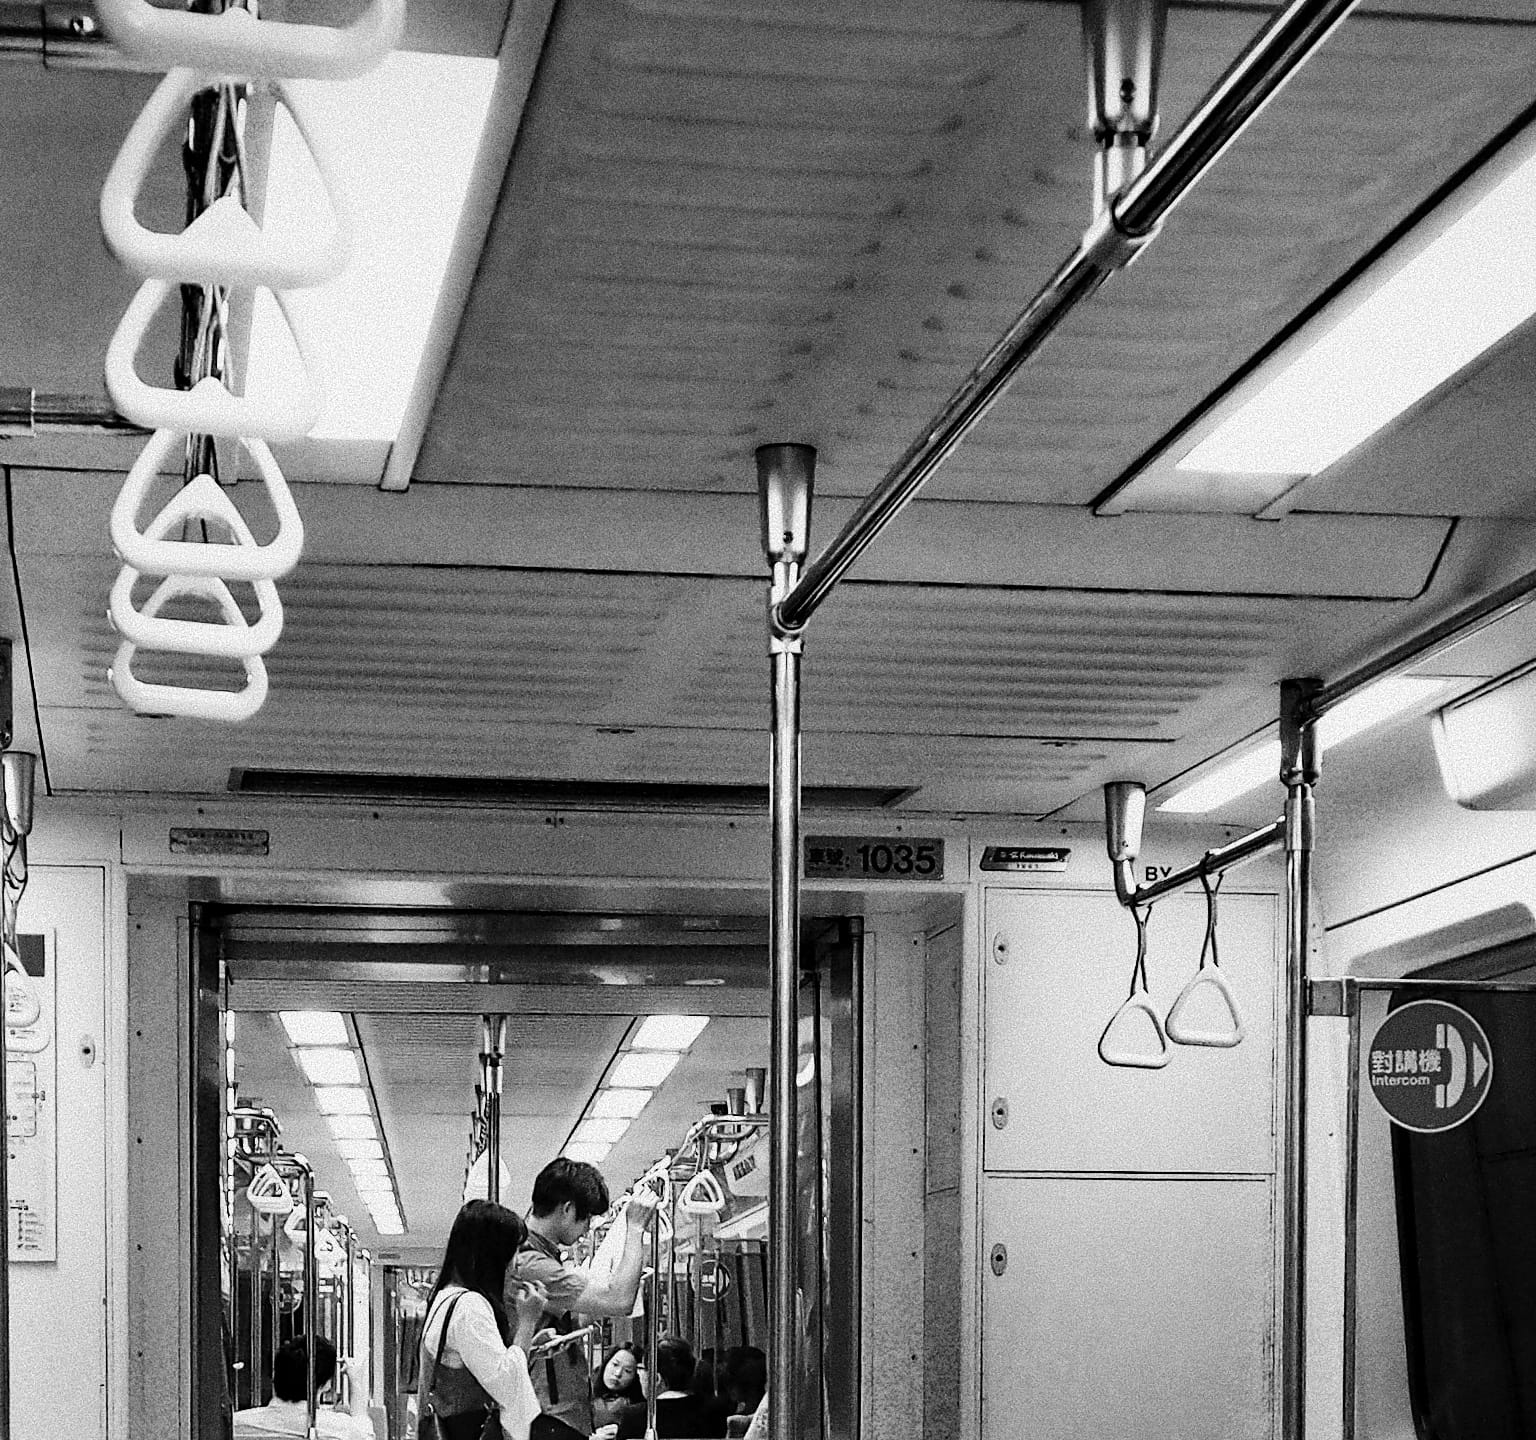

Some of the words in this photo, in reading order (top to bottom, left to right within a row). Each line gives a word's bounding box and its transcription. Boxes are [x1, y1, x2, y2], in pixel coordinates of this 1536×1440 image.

[856, 844, 936, 874] 1035
[1371, 1049, 1441, 1074] 對講機
[1371, 1075, 1431, 1086] Intercom
